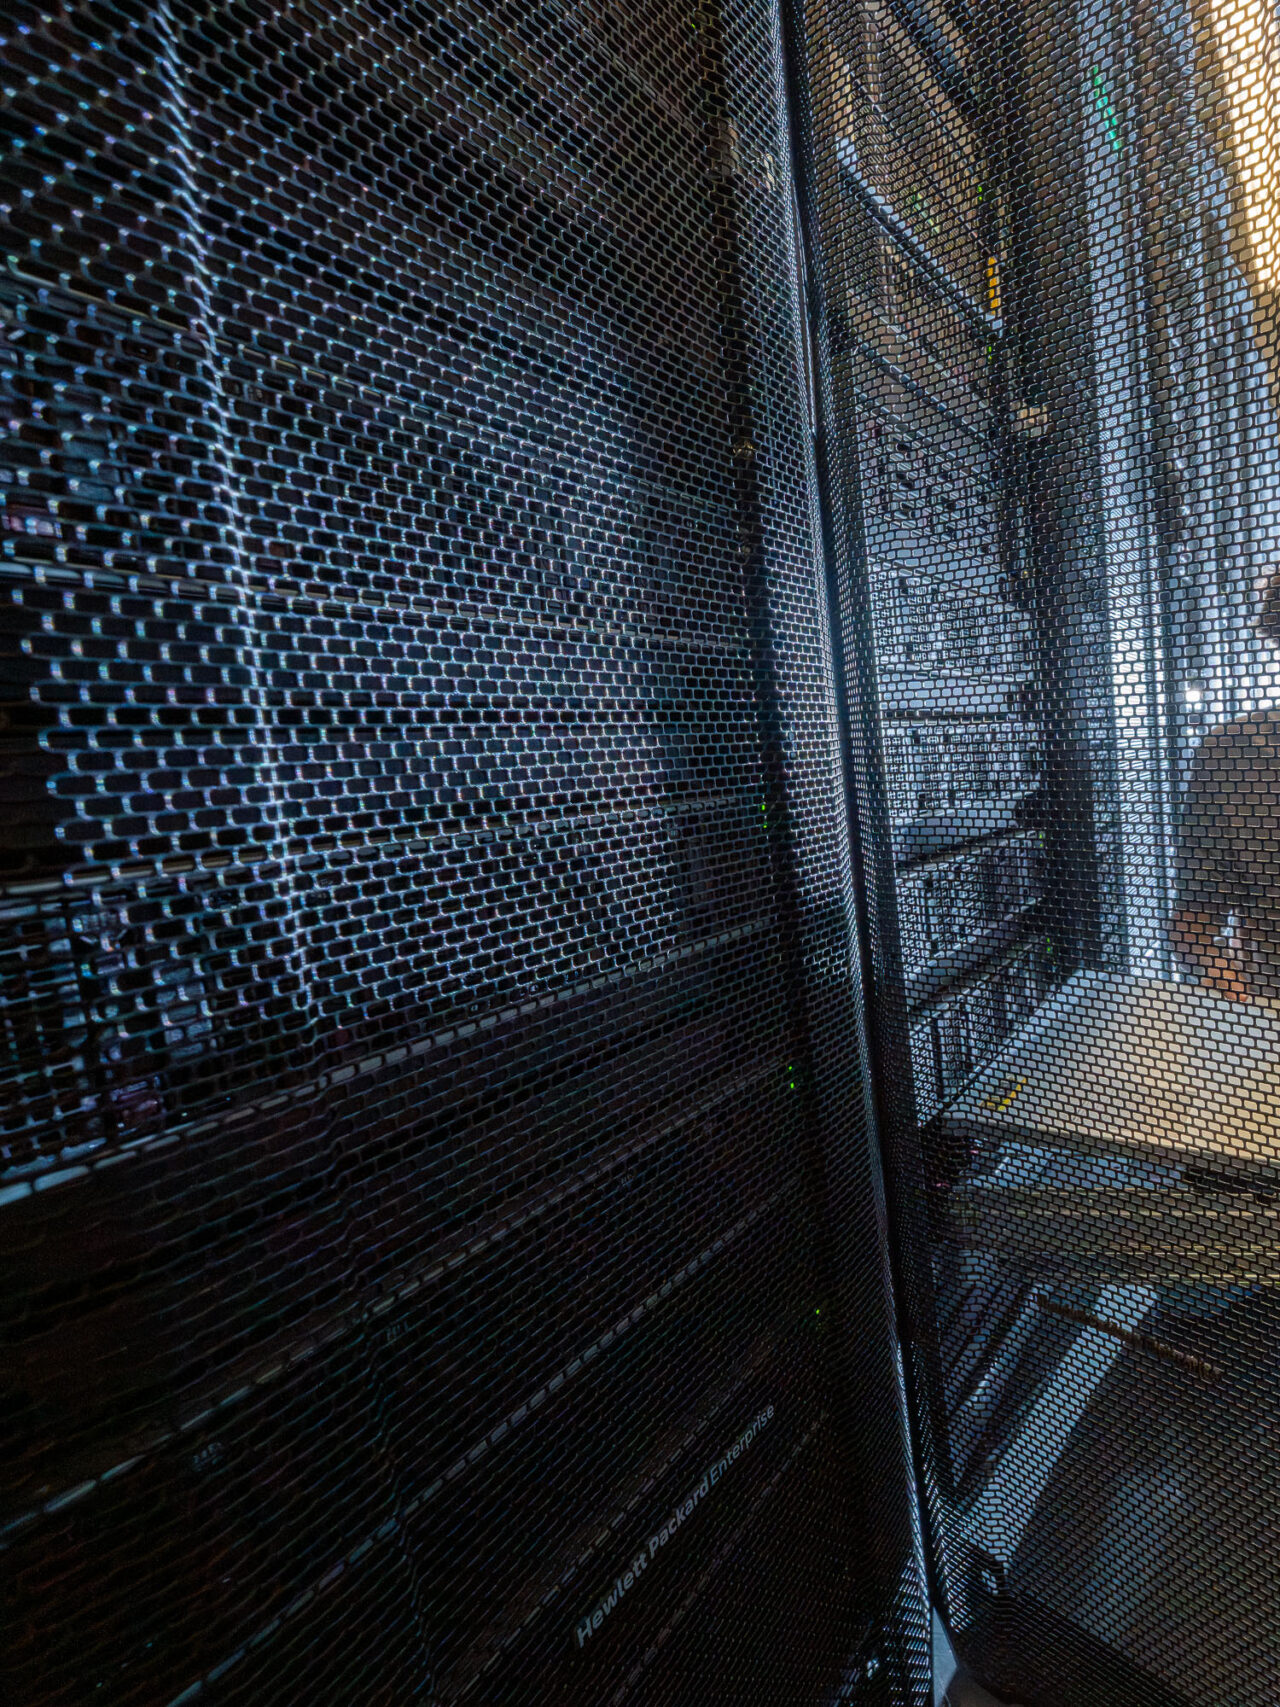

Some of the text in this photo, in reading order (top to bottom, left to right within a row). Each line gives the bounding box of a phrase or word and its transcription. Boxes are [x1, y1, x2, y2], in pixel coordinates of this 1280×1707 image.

[575, 1403, 776, 1649] Hewlett Packard Enterprise
